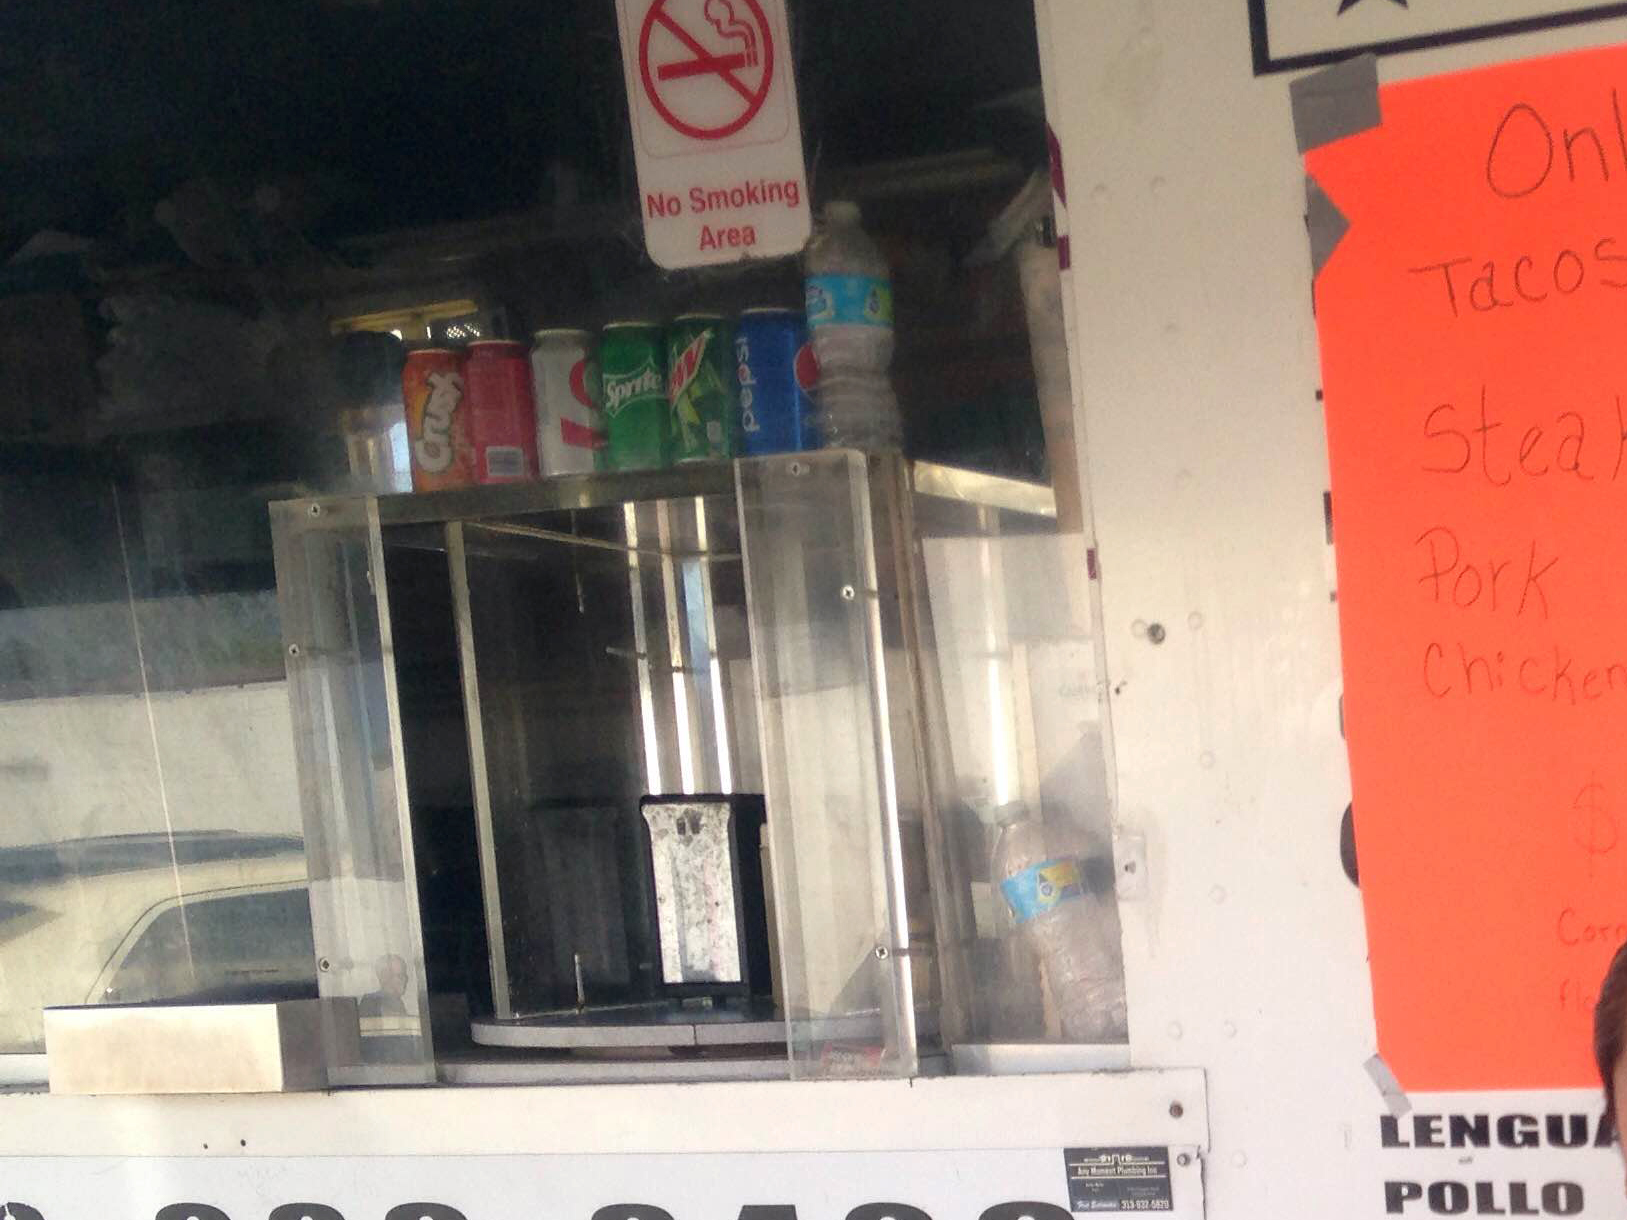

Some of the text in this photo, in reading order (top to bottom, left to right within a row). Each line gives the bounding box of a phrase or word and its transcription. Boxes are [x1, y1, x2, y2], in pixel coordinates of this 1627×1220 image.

[646, 178, 800, 219] No Smoking
[699, 224, 757, 251] Area
[605, 367, 662, 408] Sprite
[735, 336, 760, 432] pepsi
[1414, 526, 1559, 619] Pork
[1384, 1180, 1585, 1216] POLLO
